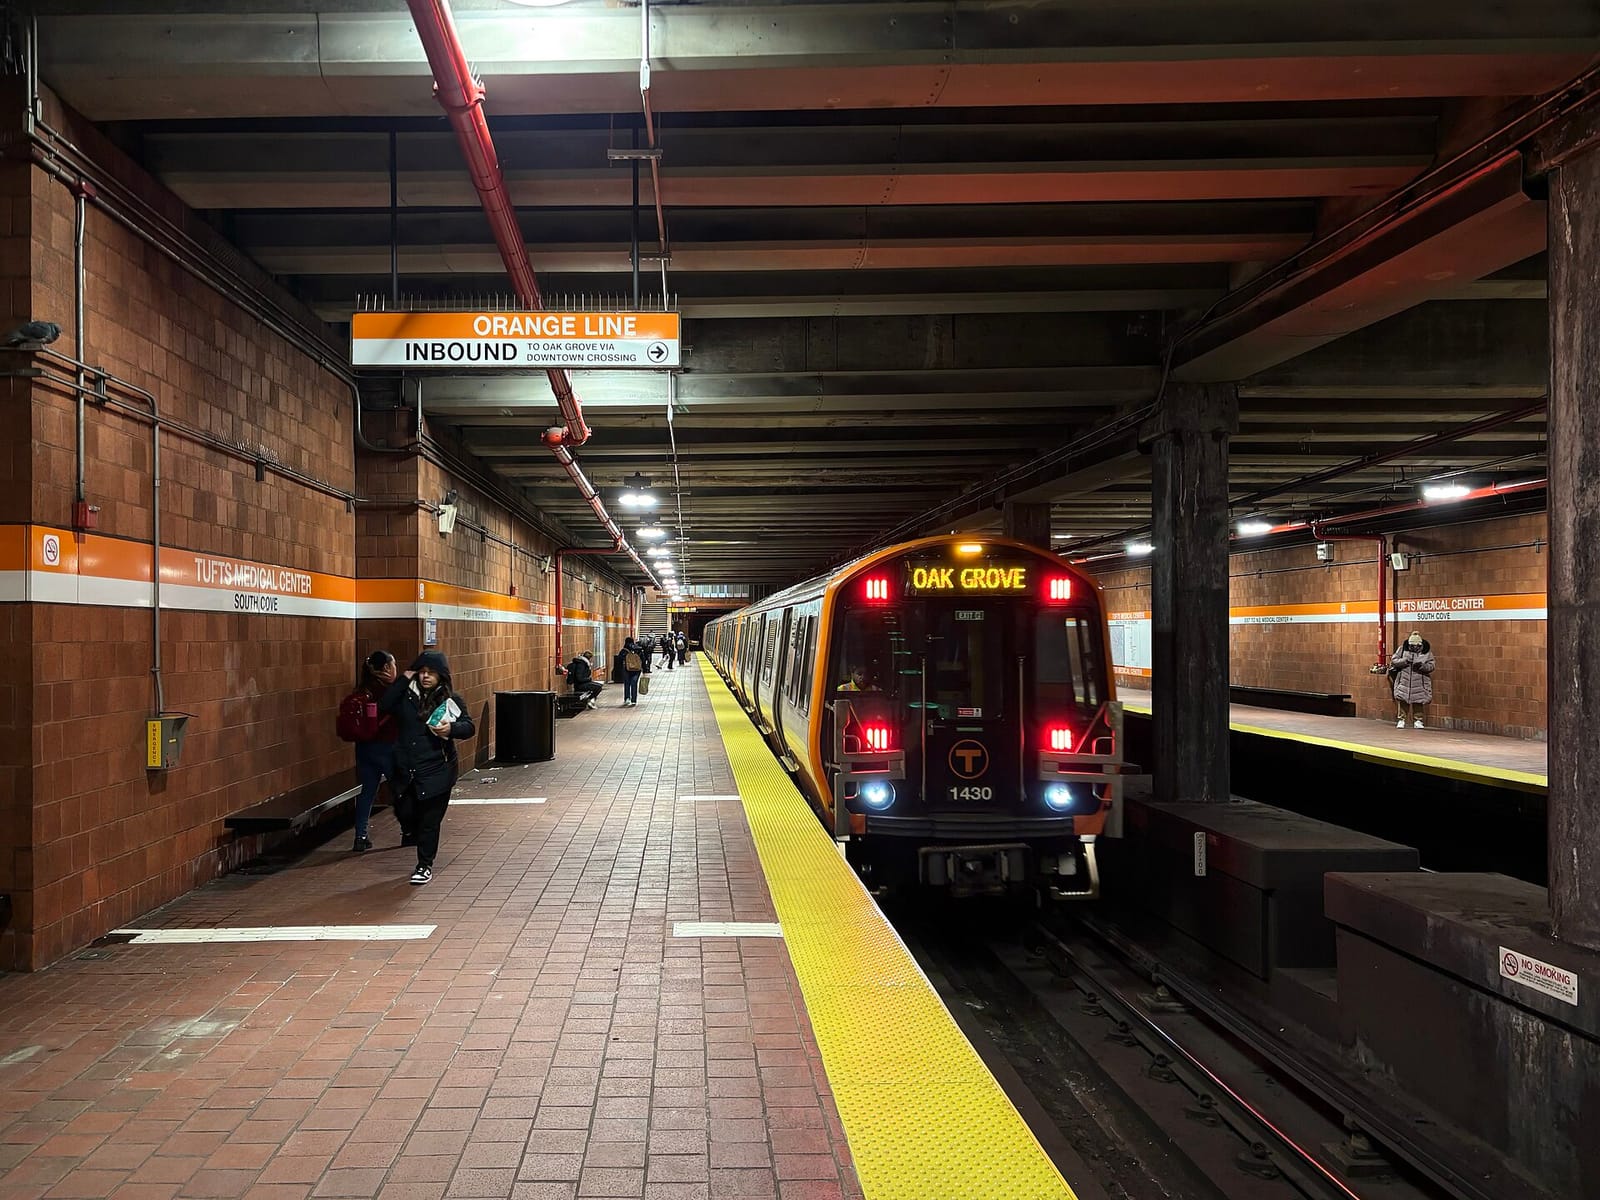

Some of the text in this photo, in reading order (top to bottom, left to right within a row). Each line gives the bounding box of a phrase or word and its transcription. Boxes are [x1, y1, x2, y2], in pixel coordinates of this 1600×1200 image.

[473, 315, 637, 337] ORANGE LINE
[405, 342, 518, 361] INBOUND
[527, 343, 615, 351] TO OAK GROVE VIA
[527, 353, 637, 362] DOWNTOWN CROSSING
[194, 557, 312, 595] TUFTS MEDICAL CENTER
[913, 568, 1026, 589] OAK GROVE
[234, 593, 278, 611] SOUTH COVE
[1417, 599, 1450, 611] MEDICAL
[1452, 598, 1484, 609] CENTER
[956, 749, 982, 773] T
[950, 787, 992, 801] 1430
[1521, 959, 1532, 970] NO
[1534, 963, 1571, 985] SMOKING
